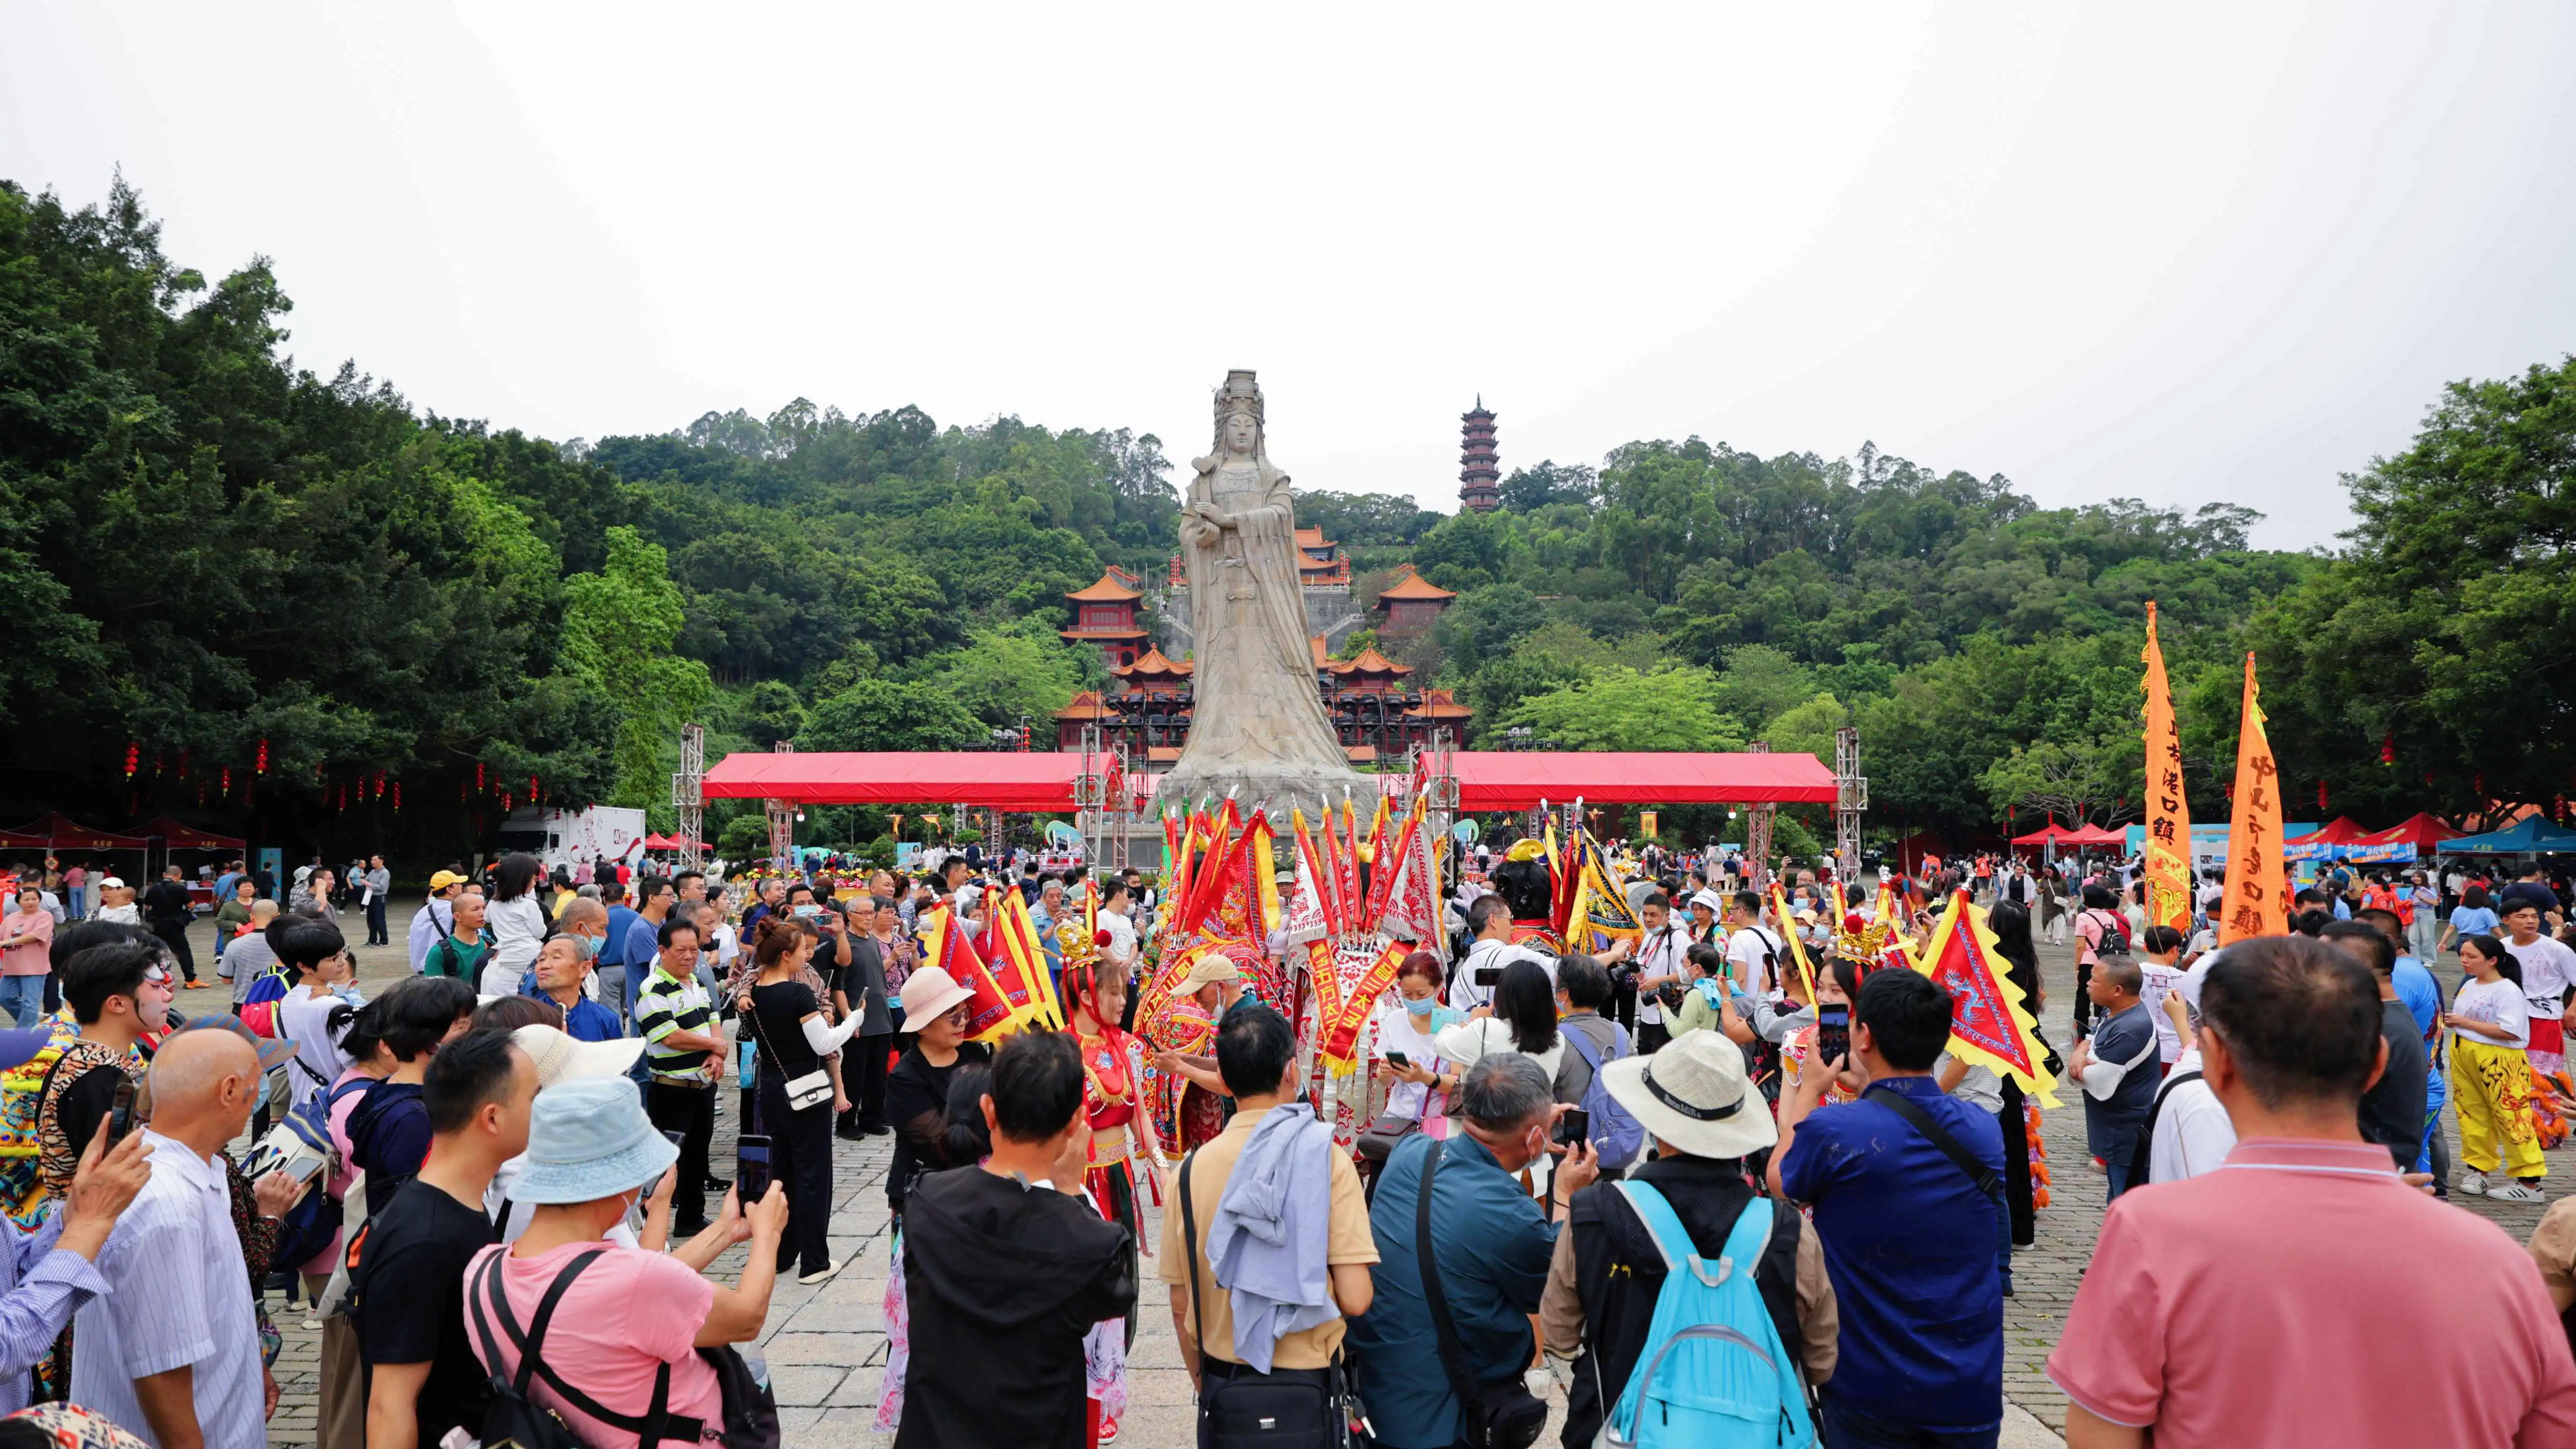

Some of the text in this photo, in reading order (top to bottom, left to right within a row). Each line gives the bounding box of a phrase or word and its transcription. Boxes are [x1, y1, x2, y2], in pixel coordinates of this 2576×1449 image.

[2153, 695, 2181, 846] 山市港口鎮
